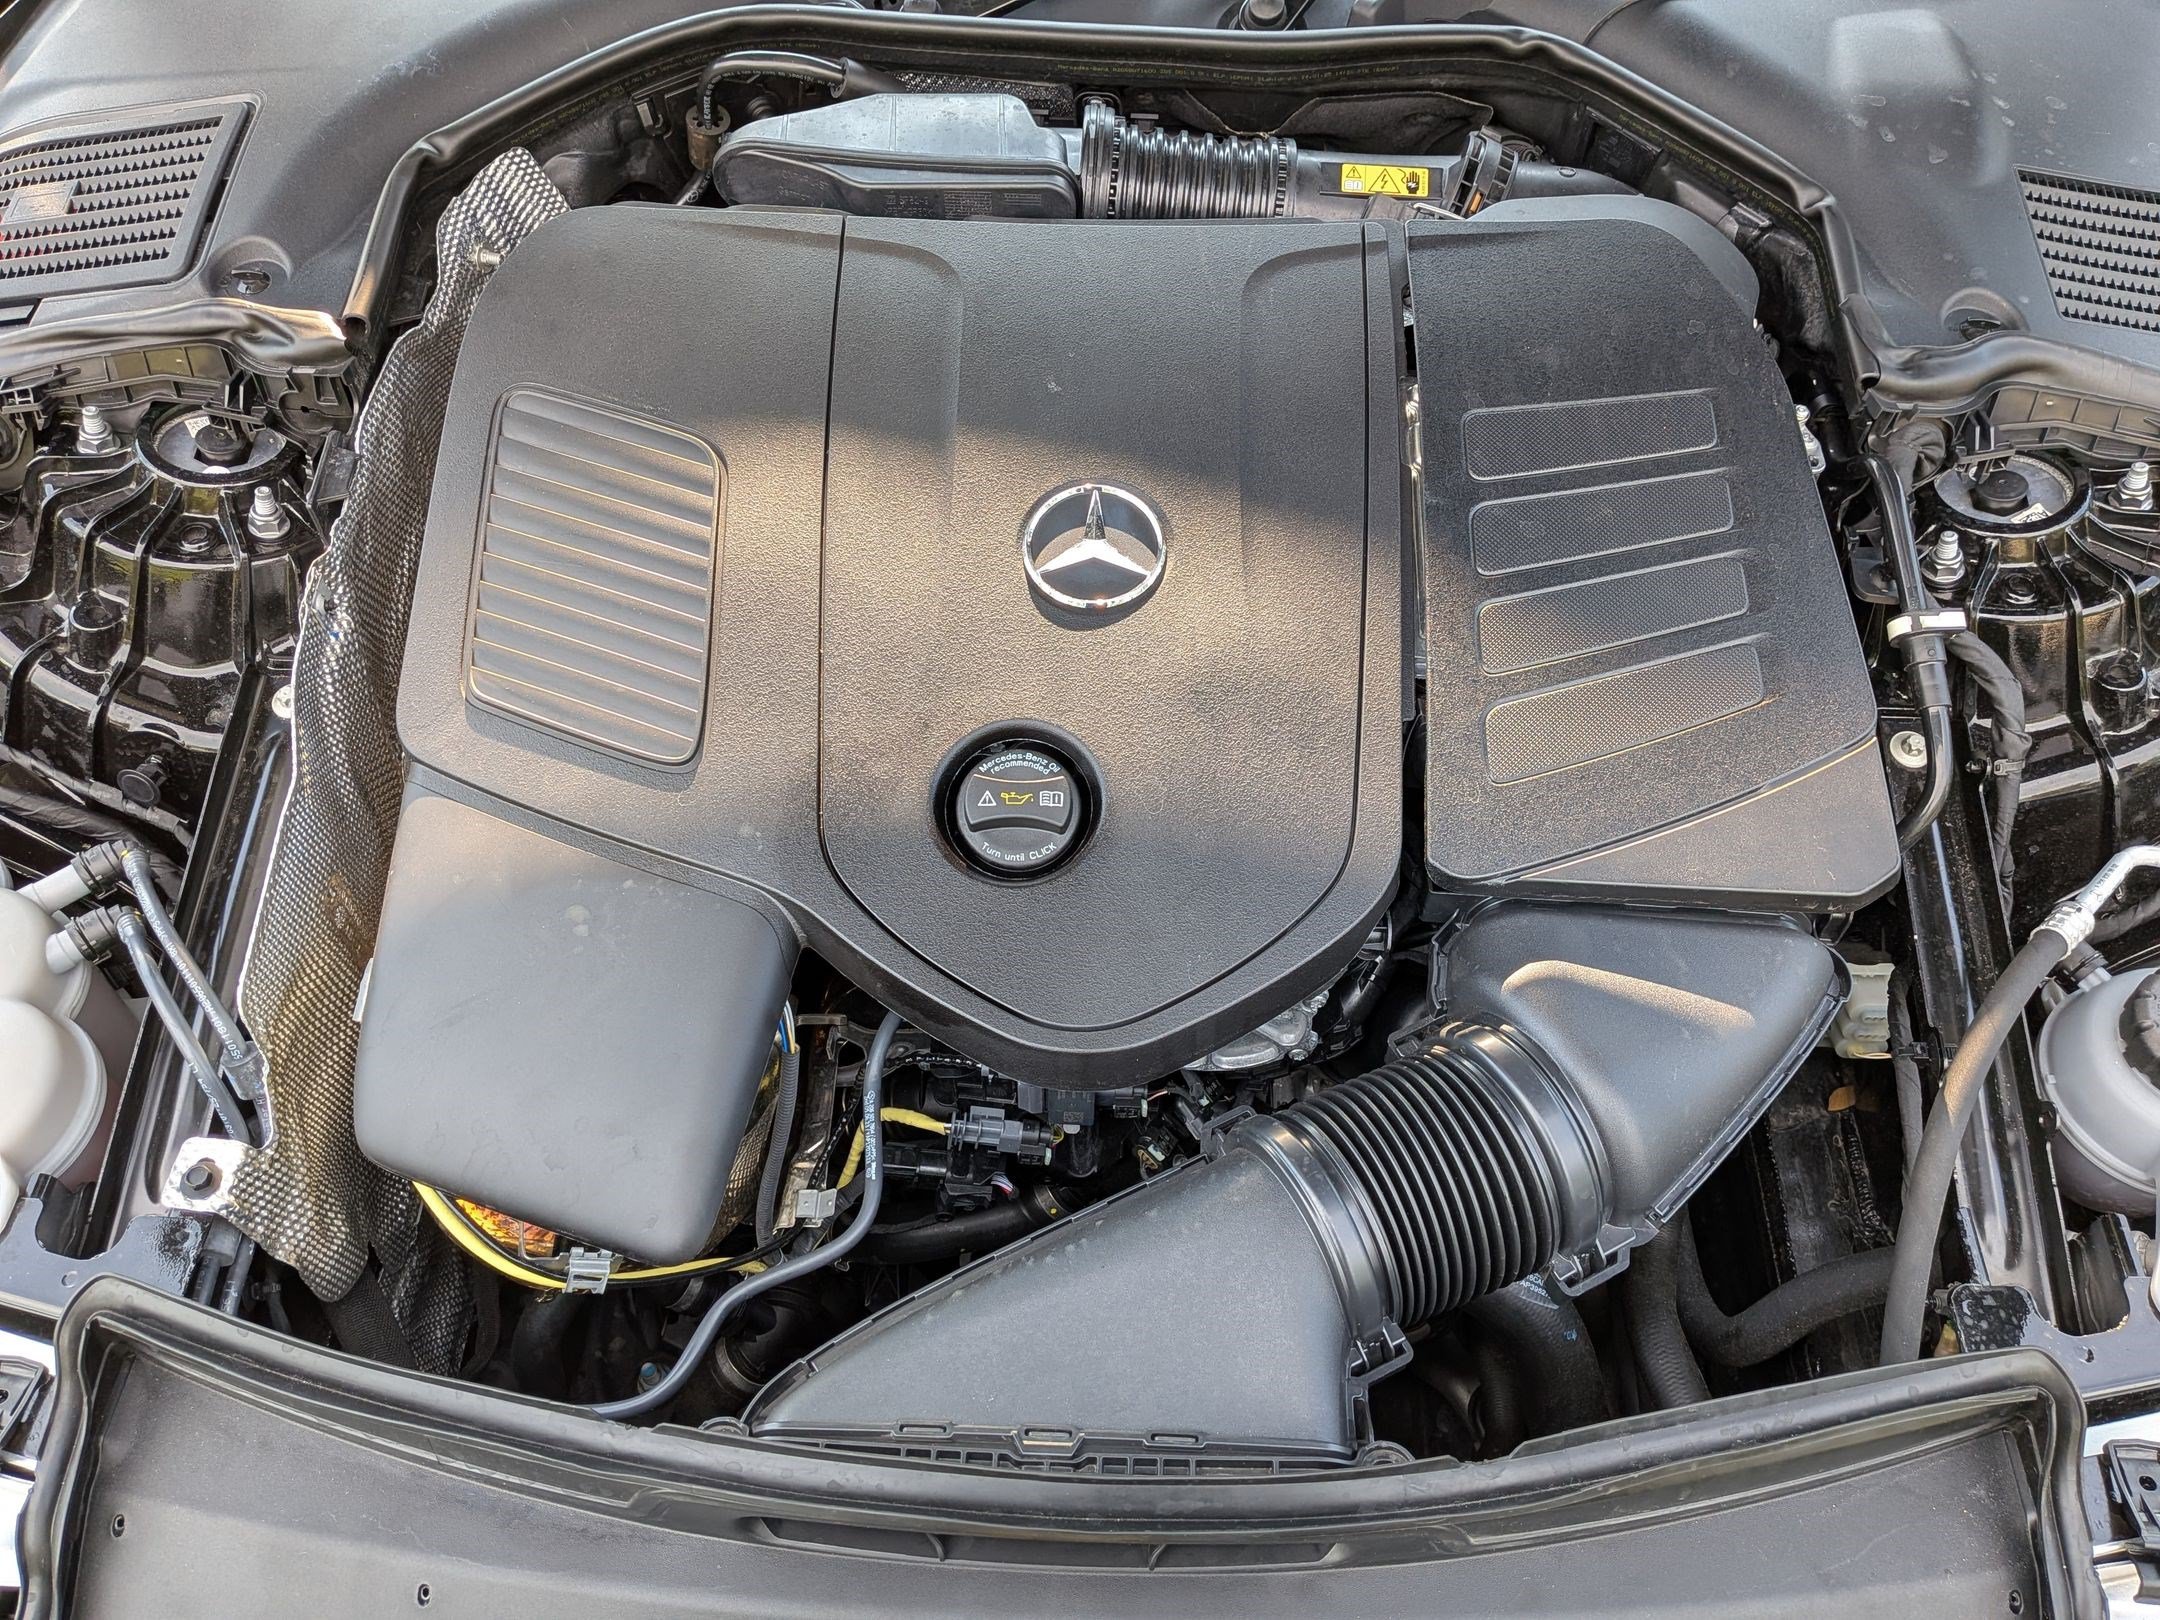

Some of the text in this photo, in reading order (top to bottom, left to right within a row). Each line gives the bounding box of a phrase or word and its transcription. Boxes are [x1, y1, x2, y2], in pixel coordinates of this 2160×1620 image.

[978, 752, 1061, 773] Mercedes-Benz Oil
[990, 760, 1051, 775] recommended
[981, 841, 1057, 861] Turn until CLICK
